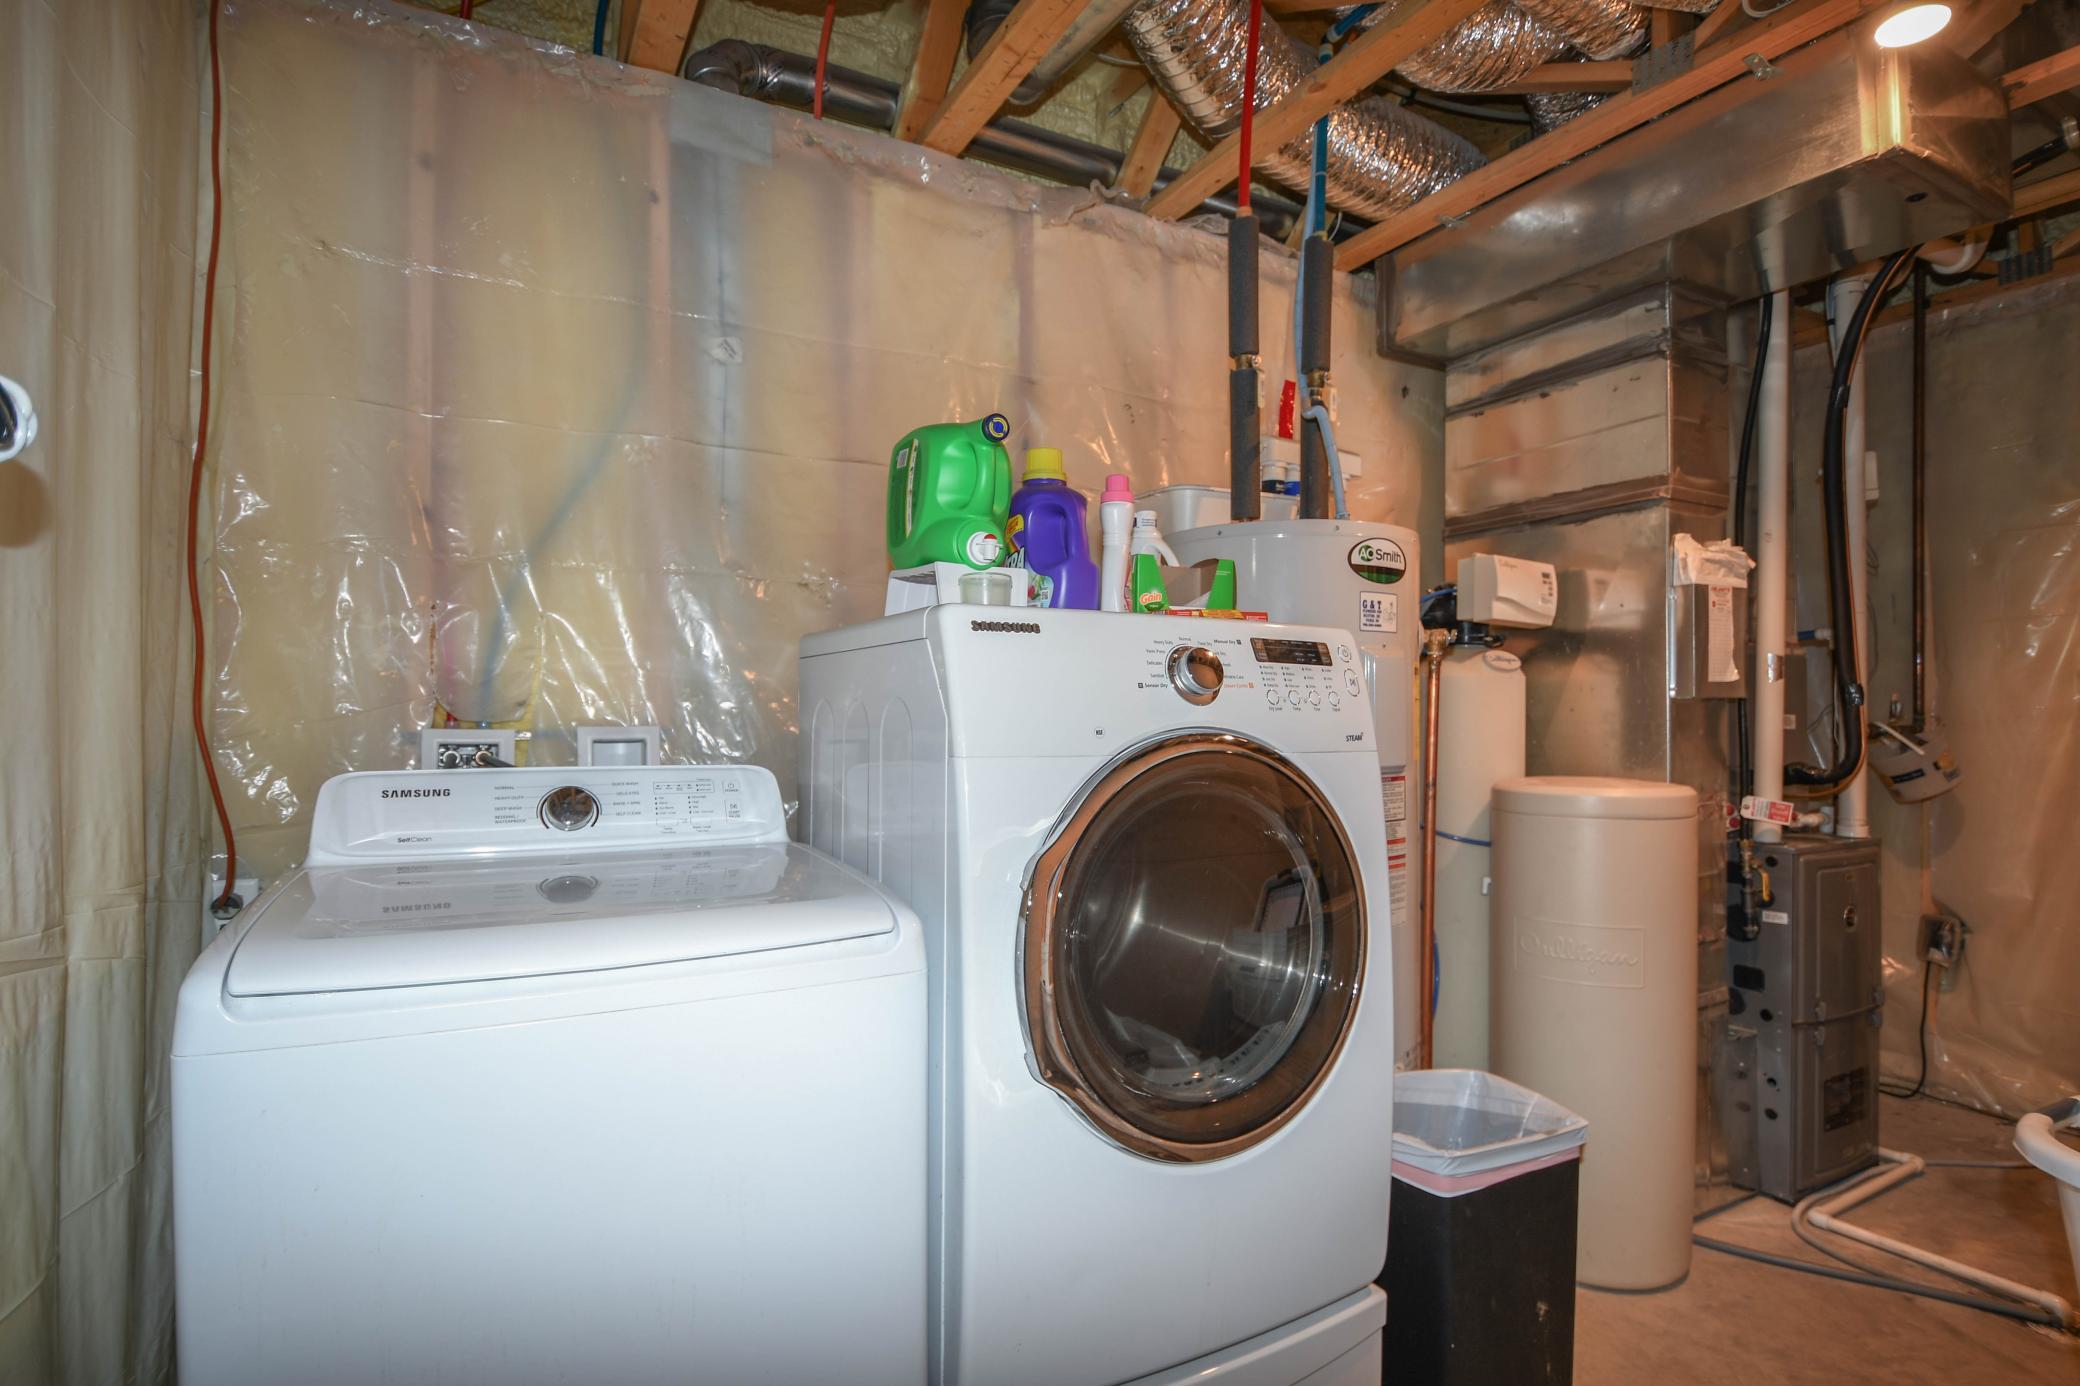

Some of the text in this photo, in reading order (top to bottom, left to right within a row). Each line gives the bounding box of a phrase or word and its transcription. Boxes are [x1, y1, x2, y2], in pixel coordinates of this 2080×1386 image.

[1375, 548, 1402, 564] Smith
[1140, 592, 1162, 605] Gain
[1362, 599, 1382, 610] G & T
[971, 620, 1041, 634] SAMSUNG
[381, 788, 451, 799] SAMSUNG
